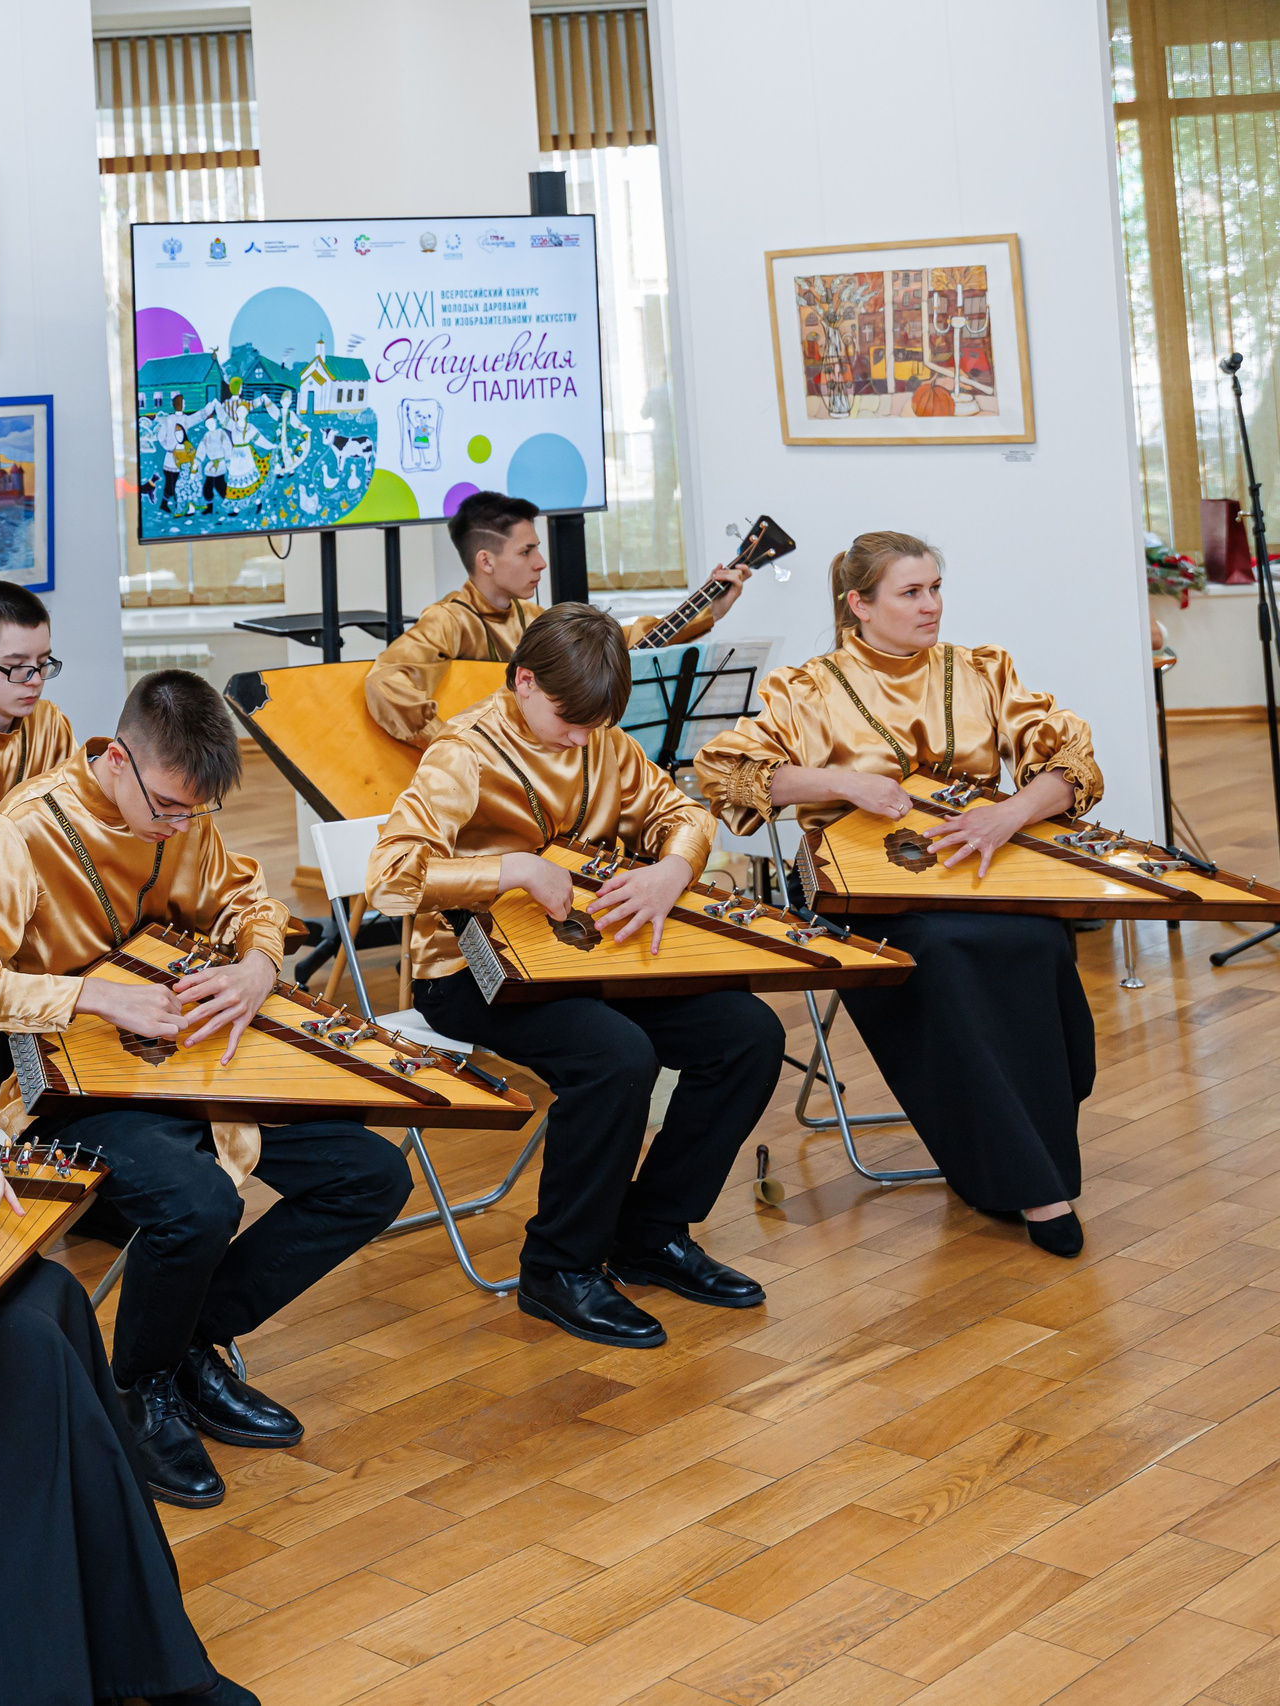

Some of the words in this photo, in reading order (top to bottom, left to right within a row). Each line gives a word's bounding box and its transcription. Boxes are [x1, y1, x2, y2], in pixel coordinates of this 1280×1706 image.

[441, 288, 503, 300] ВСЕРОССИЙСКИЙ
[506, 287, 539, 297] КОНКУРС
[377, 291, 434, 329] XXXI
[441, 303, 479, 313] МОЛОДЫХ
[483, 300, 527, 312] ДАРОВАНИЙ
[442, 317, 451, 327] ПО
[455, 315, 532, 327] ИЗОБРАЗИТЕЛЬНОМУ
[535, 313, 577, 323] ИСКУССТВУ
[375, 330, 577, 394] Жигулевская
[473, 376, 578, 402] ПАЛИТРА
